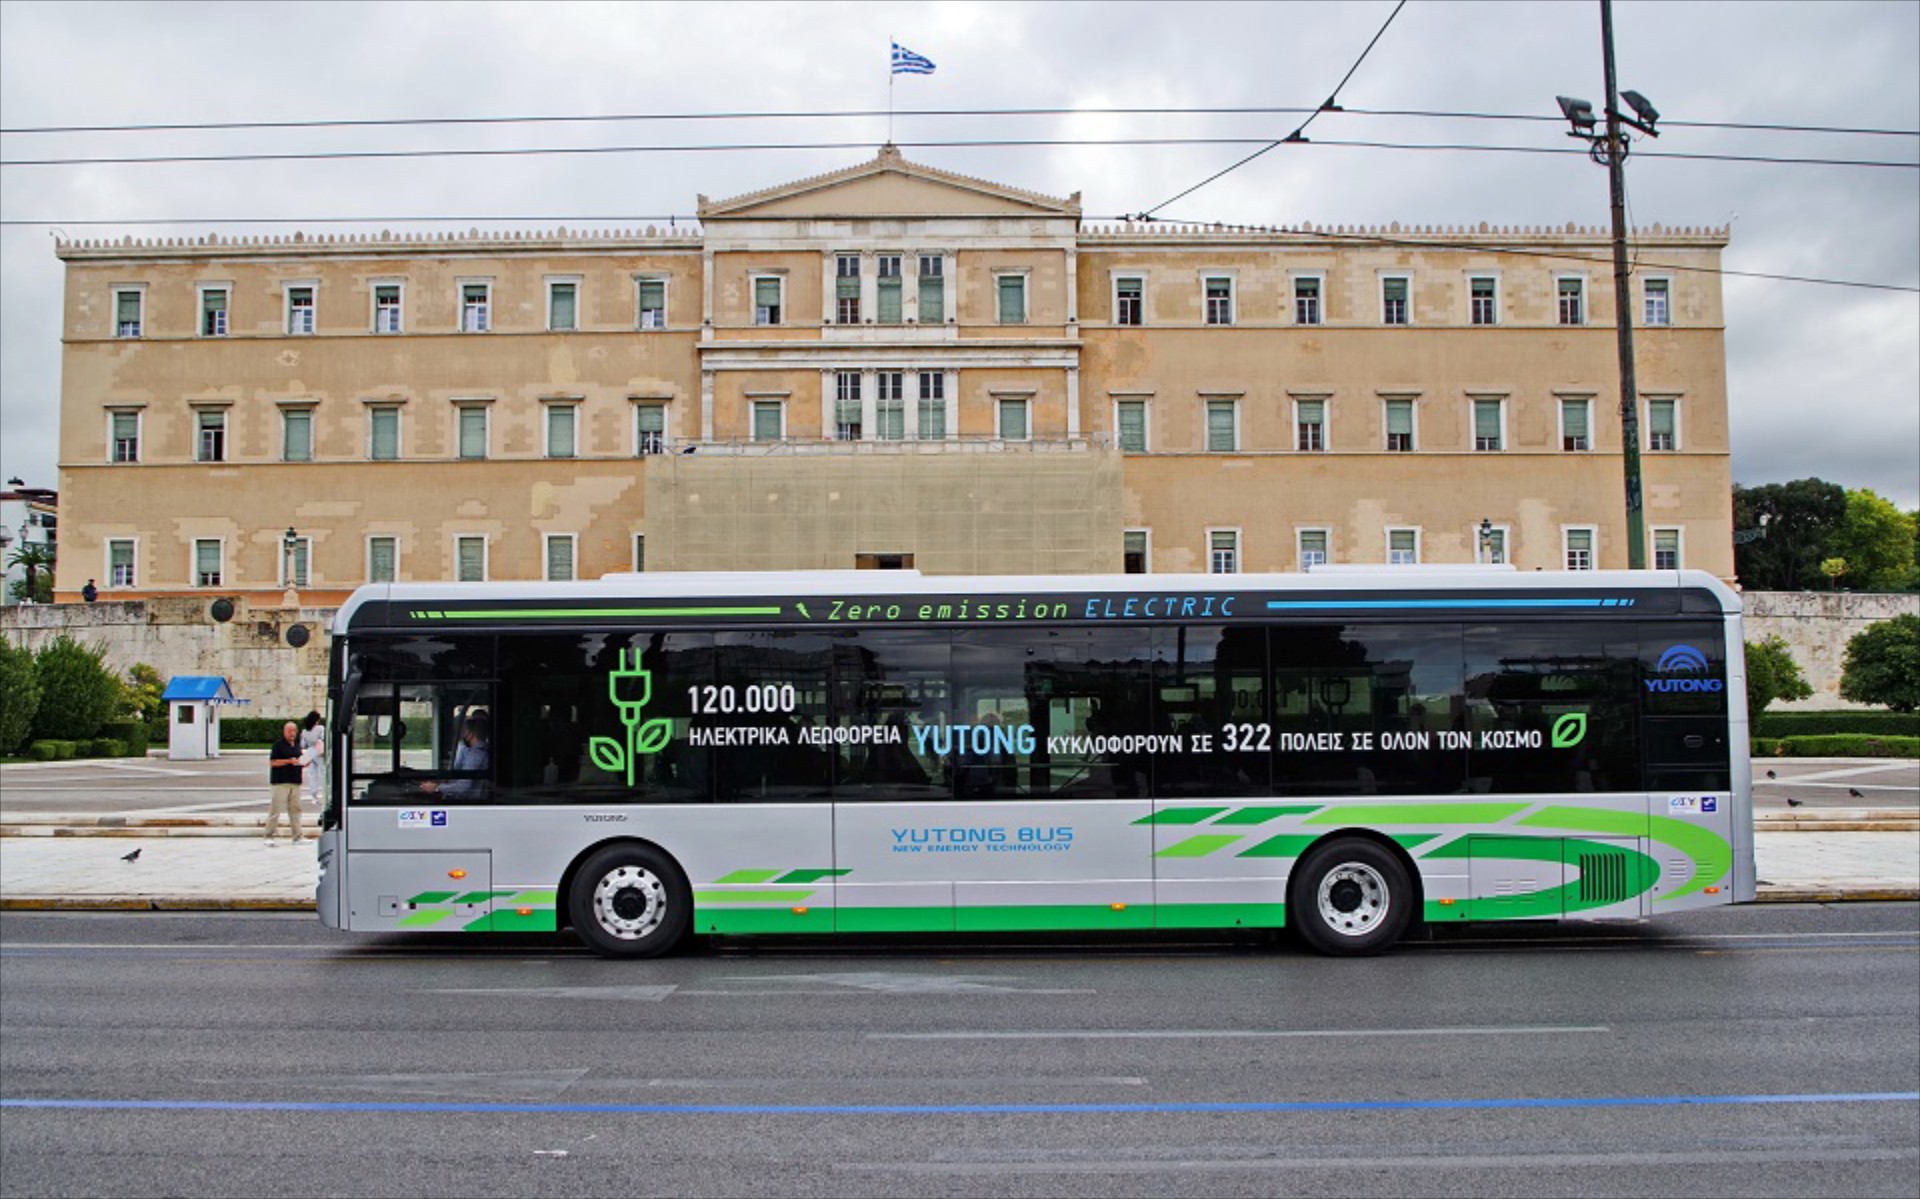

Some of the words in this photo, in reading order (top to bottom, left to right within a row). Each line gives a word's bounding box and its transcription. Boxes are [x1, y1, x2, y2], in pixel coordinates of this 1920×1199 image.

[828, 601, 900, 620] Zero
[918, 601, 1068, 620] emission
[1085, 597, 1235, 618] ELECTRIC
[1644, 679, 1723, 692] YUTONG
[688, 685, 795, 713] 120.000
[689, 727, 789, 746] ΗΛΕΚΤΡΙΚΑ
[798, 725, 902, 744] ΛΕΩΦΟΡΕΙΑ
[912, 725, 1036, 755] YUTONG
[1047, 735, 1182, 754] ΚΥΚΛΟΦΟΡΟΥΝ
[1192, 735, 1213, 752] ΣΕ
[1222, 724, 1271, 752] 322
[1281, 733, 1344, 750] ΠΟΛΕΙΣ
[1351, 733, 1373, 750] ΣΕ
[1381, 732, 1429, 750] ΟΛΟΝ
[1437, 731, 1472, 749] ΤΟΝ
[1481, 730, 1541, 748] ΚΟΣΜΟ
[891, 828, 1007, 842] YUTONG
[1018, 827, 1073, 842] BUS
[927, 844, 978, 852] ENERGY
[987, 843, 1071, 851] TECHNOLOGY
